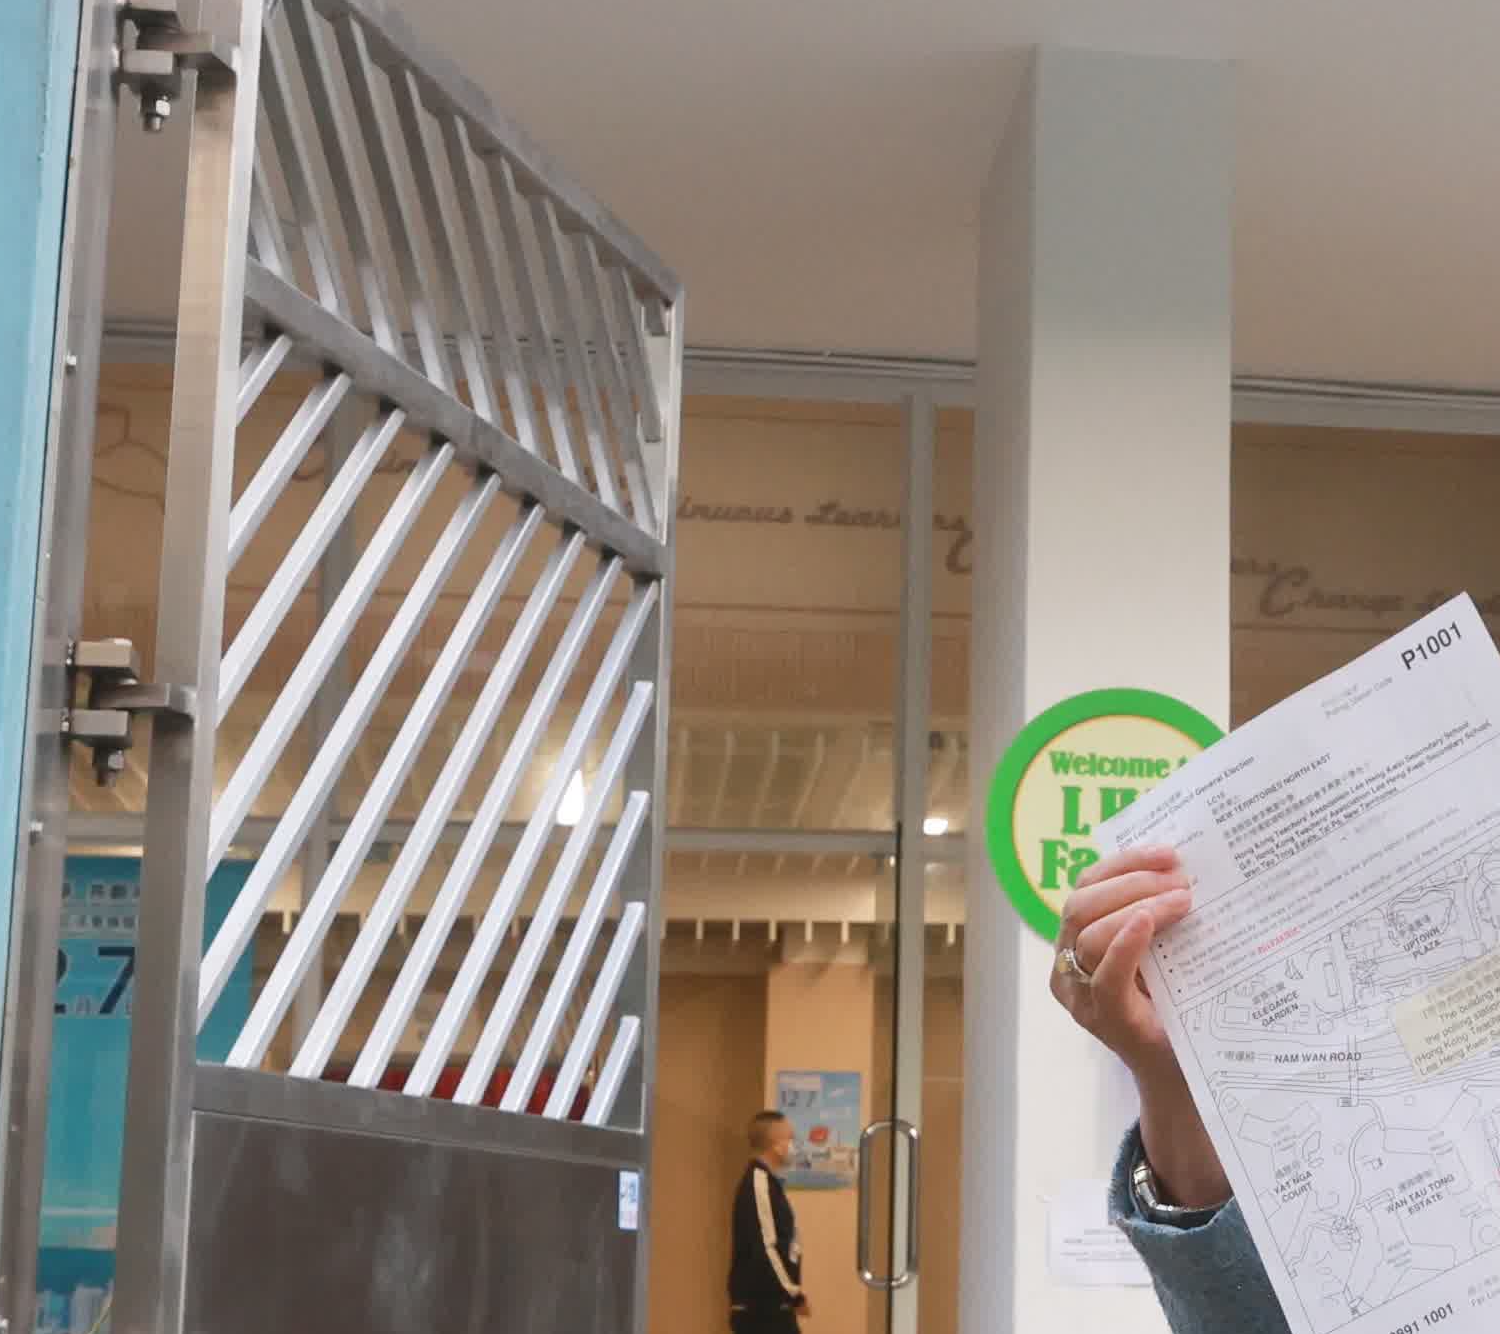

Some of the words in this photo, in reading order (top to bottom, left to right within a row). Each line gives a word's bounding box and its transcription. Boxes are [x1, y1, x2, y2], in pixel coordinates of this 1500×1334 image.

[1400, 621, 1463, 671] P1001
[1050, 750, 1171, 779] Welcome
[1213, 808, 1235, 825] NEW
[1281, 764, 1312, 786] NORTH
[1308, 751, 1333, 770] EAST
[1403, 926, 1440, 952] UPTOWN
[1412, 939, 1441, 959] PLAZA
[1251, 990, 1299, 1020] ELEGANCE
[1262, 1003, 1300, 1027] GARDEN
[1274, 1053, 1300, 1065] NAM
[1302, 1052, 1327, 1064] WAN
[1329, 1051, 1363, 1063] ROAD
[1273, 1179, 1295, 1196] YAT
[1293, 1170, 1313, 1187] NGA
[1280, 1183, 1313, 1204] COURT
[1386, 1196, 1408, 1214] WAN
[1406, 1188, 1427, 1206] TAU
[1427, 1173, 1455, 1194] TONG
[1407, 1192, 1444, 1215] ESTATE
[1422, 1302, 1455, 1327] 1001
